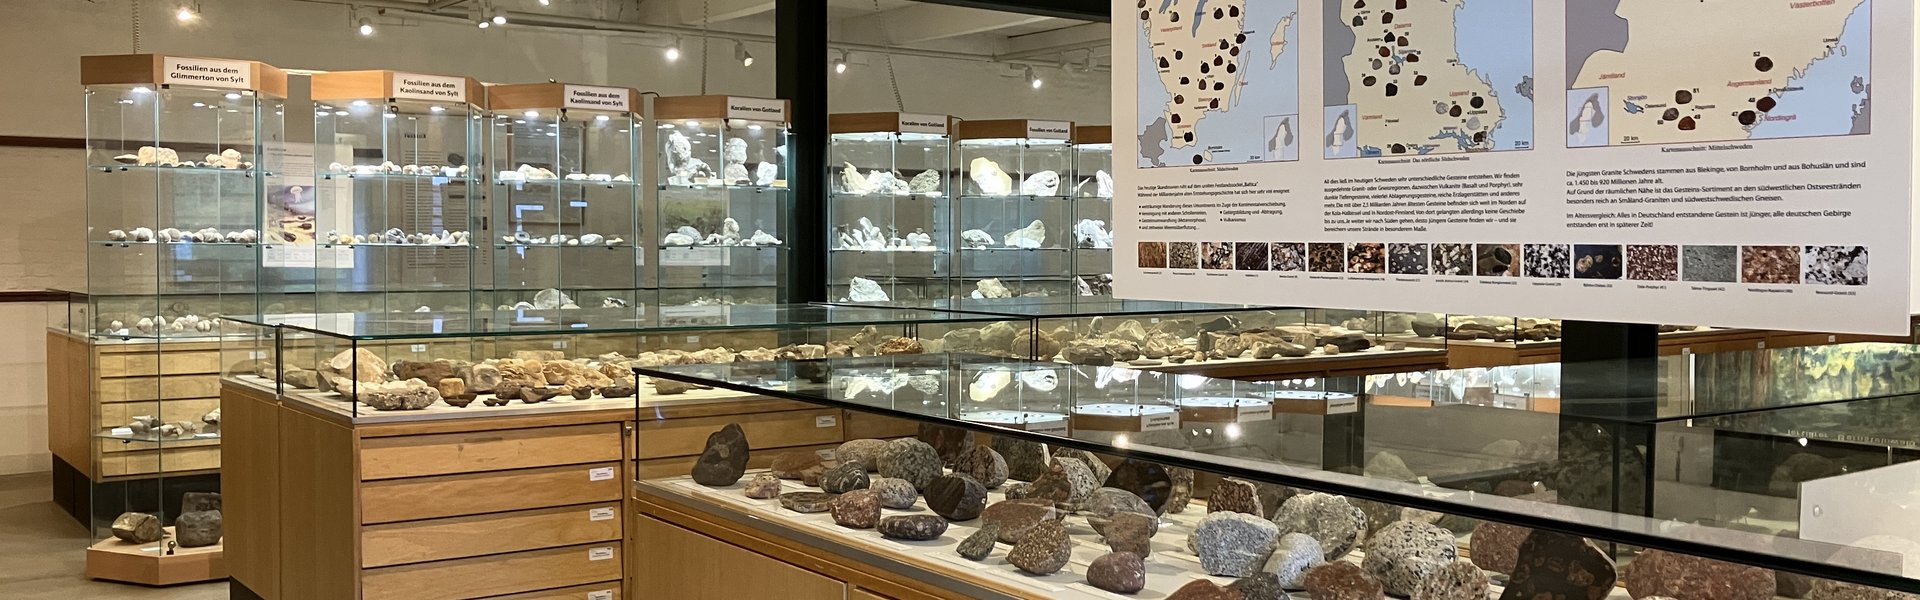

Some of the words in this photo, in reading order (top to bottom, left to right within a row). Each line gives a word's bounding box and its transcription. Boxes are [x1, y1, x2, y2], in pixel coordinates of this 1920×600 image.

[177, 64, 208, 72] Fossilien
[171, 73, 214, 81] Glimmerton
[231, 76, 244, 84] Sylt
[1567, 170, 1576, 178] Die
[1577, 170, 1600, 178] jüngsten
[1623, 168, 1655, 176] Schwedens
[1740, 164, 1772, 172] Bornholm
[1802, 162, 1834, 170] Bohuslän
[1611, 178, 1637, 186] Millionen
[1638, 178, 1653, 186] Jahre
[1758, 184, 1805, 192] südwestlichen
[1807, 183, 1862, 191] Ostseestränden
[1773, 210, 1784, 218] alle
[1823, 210, 1852, 218] Gebirge
